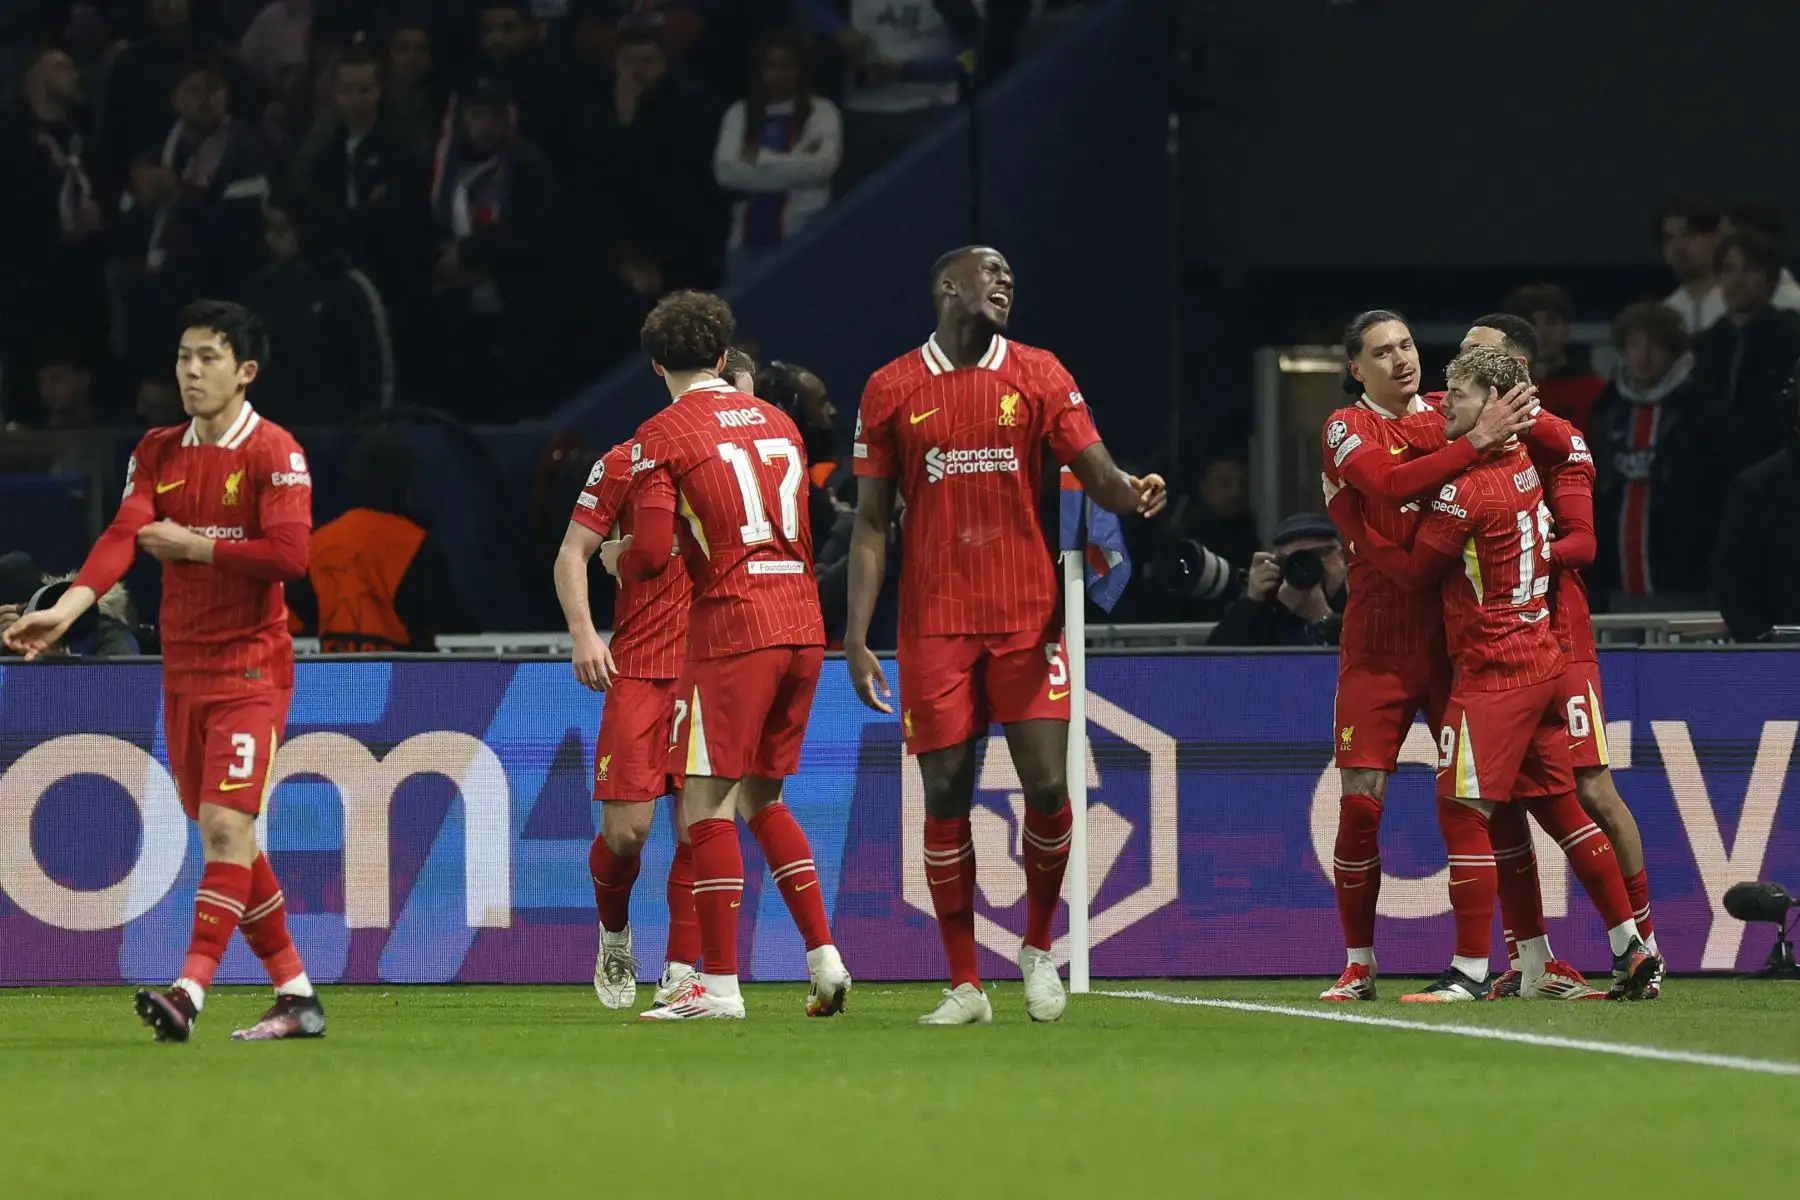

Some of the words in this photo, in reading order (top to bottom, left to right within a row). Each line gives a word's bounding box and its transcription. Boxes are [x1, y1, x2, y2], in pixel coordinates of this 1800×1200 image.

[946, 446, 1014, 462] standard
[946, 458, 1019, 474] chartered
[717, 438, 804, 546] 17
[1045, 643, 1067, 685] 5
[670, 700, 687, 744] 7
[1566, 695, 1590, 738] 6
[229, 733, 255, 778] 3
[1439, 726, 1455, 766] 9
